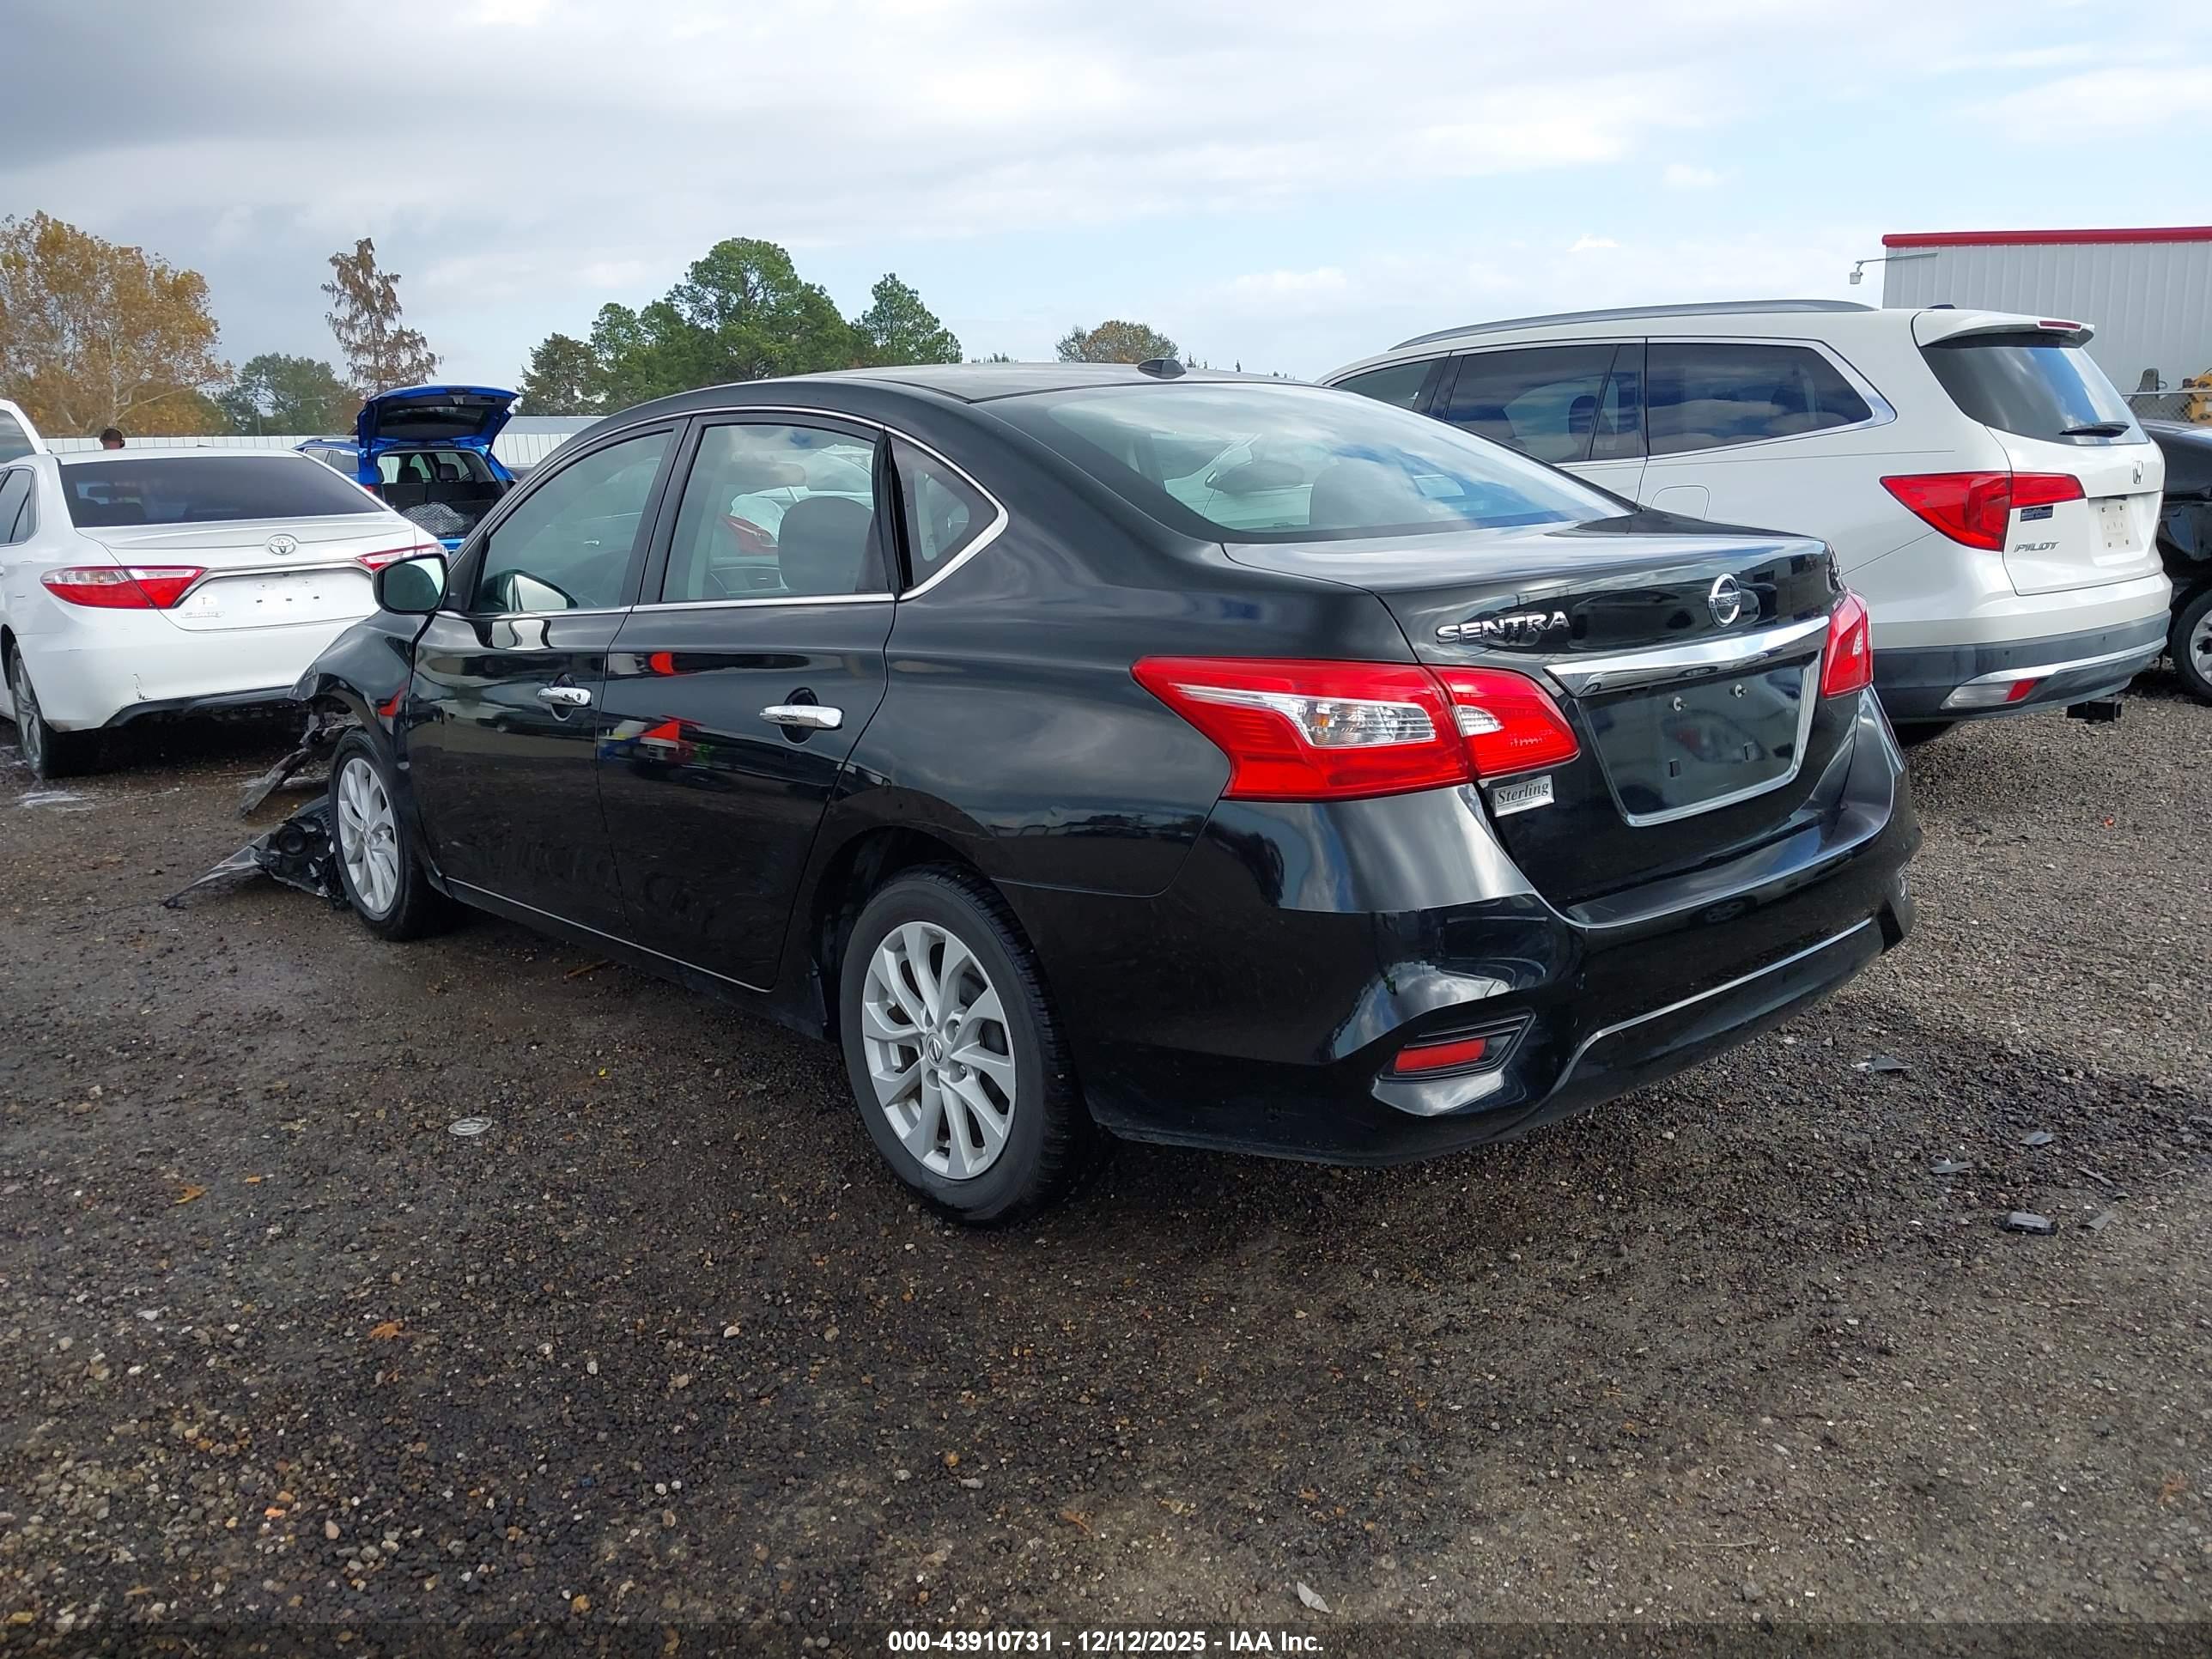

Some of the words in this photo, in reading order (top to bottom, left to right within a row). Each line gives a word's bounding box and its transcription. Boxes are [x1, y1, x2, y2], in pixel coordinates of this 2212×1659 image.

[2014, 541, 2061, 553] PILOT
[1437, 611, 1571, 644] SENTRA
[1498, 782, 1549, 804] Sterling
